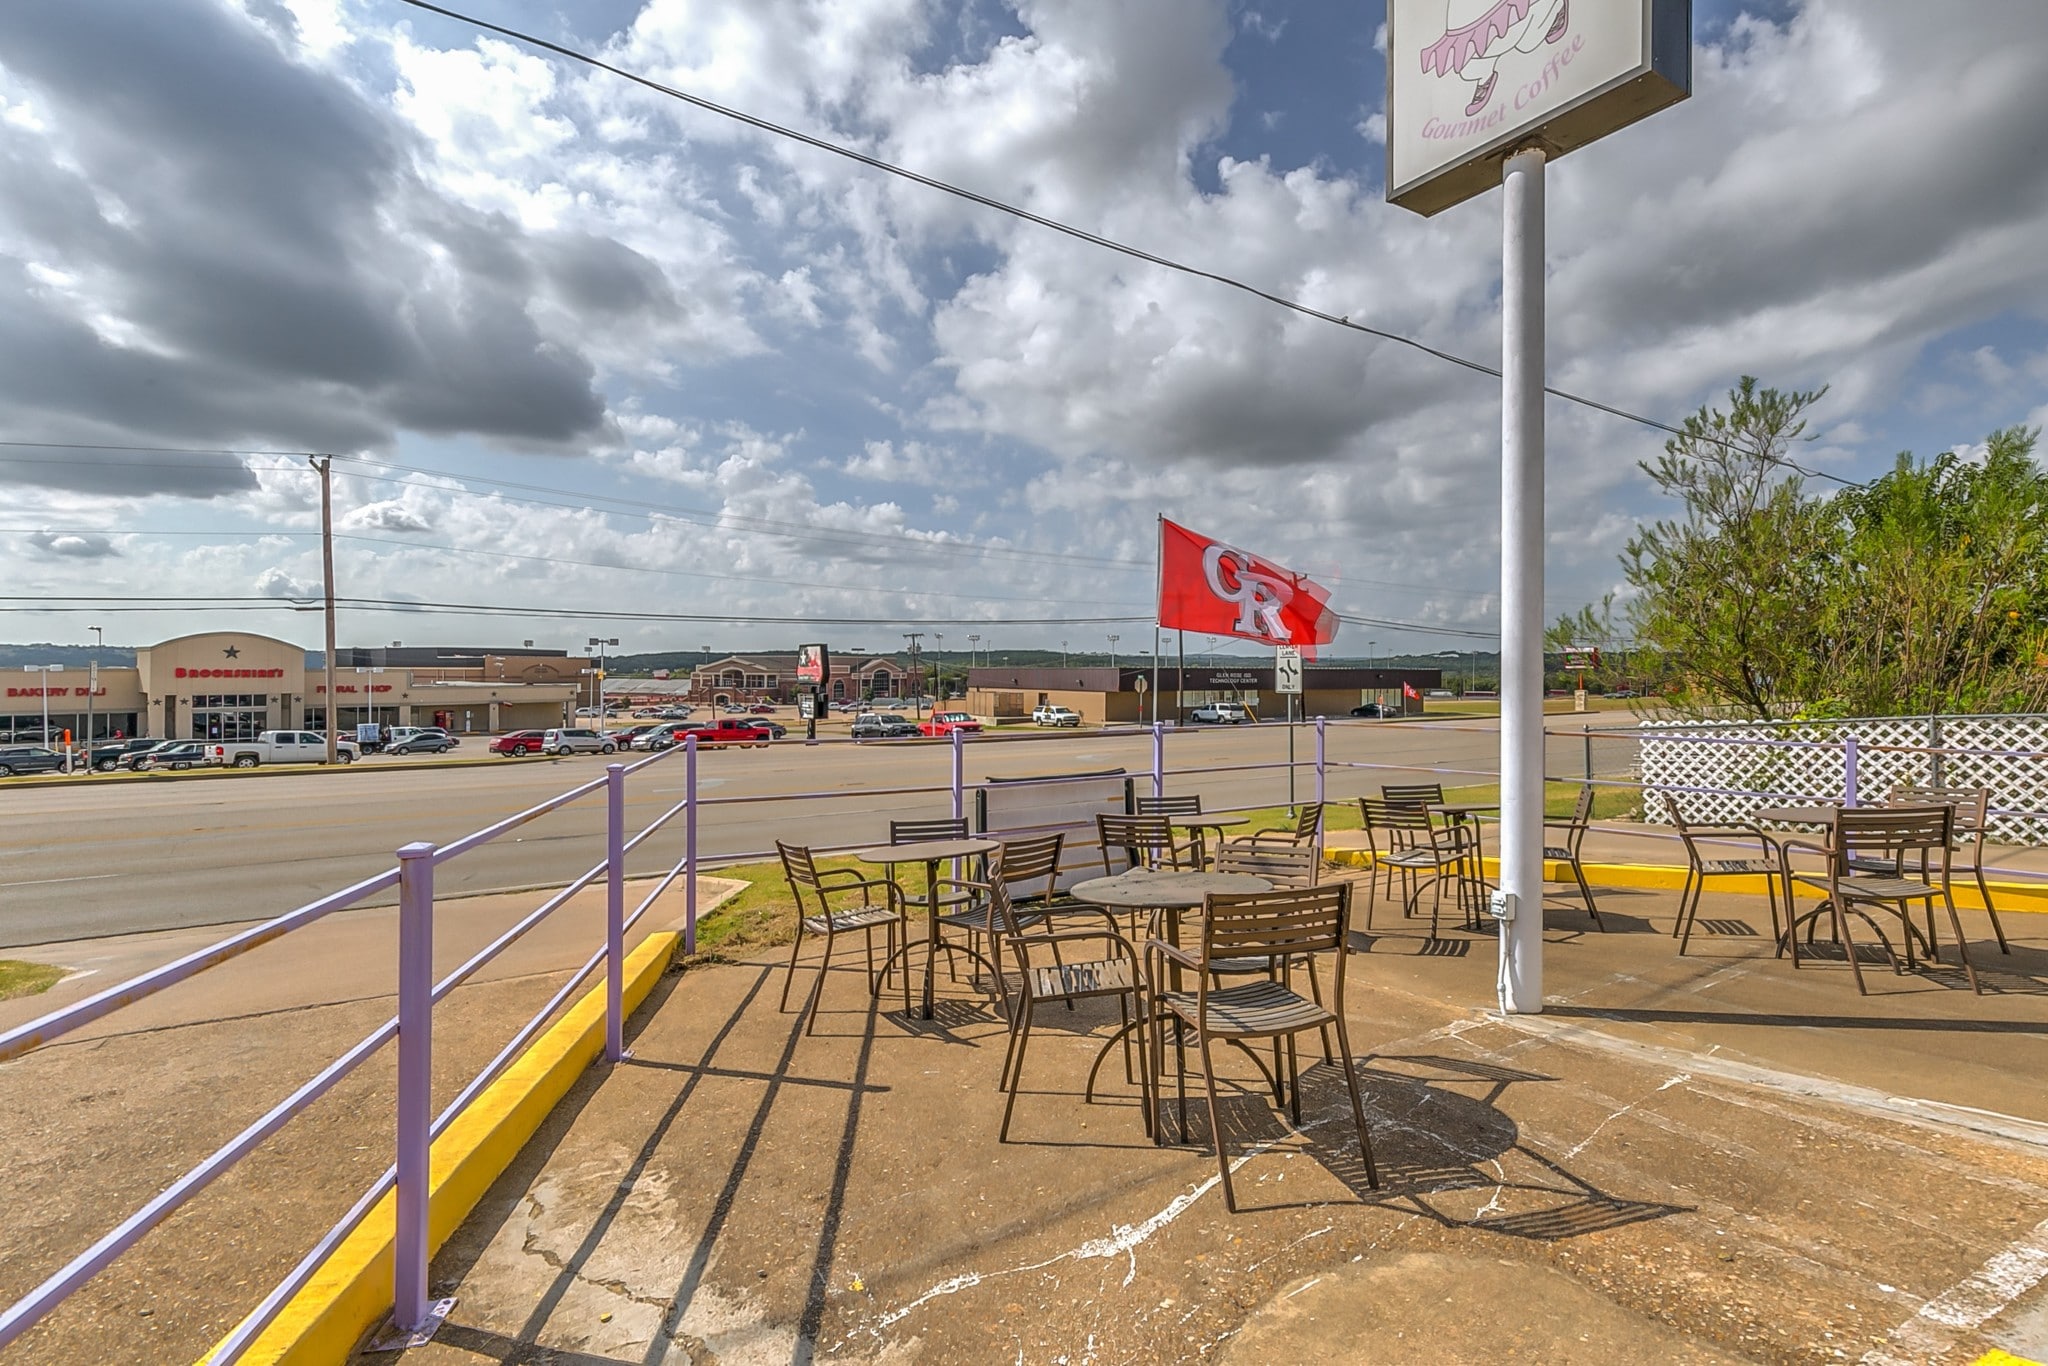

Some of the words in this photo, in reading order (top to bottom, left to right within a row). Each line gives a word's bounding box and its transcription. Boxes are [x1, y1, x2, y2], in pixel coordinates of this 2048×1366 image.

[1421, 103, 1507, 140] Gourmet
[1513, 33, 1585, 112] Coffee
[8, 688, 69, 697] BAKERY
[316, 685, 358, 693] FRAL
[363, 685, 392, 693] SHOP
